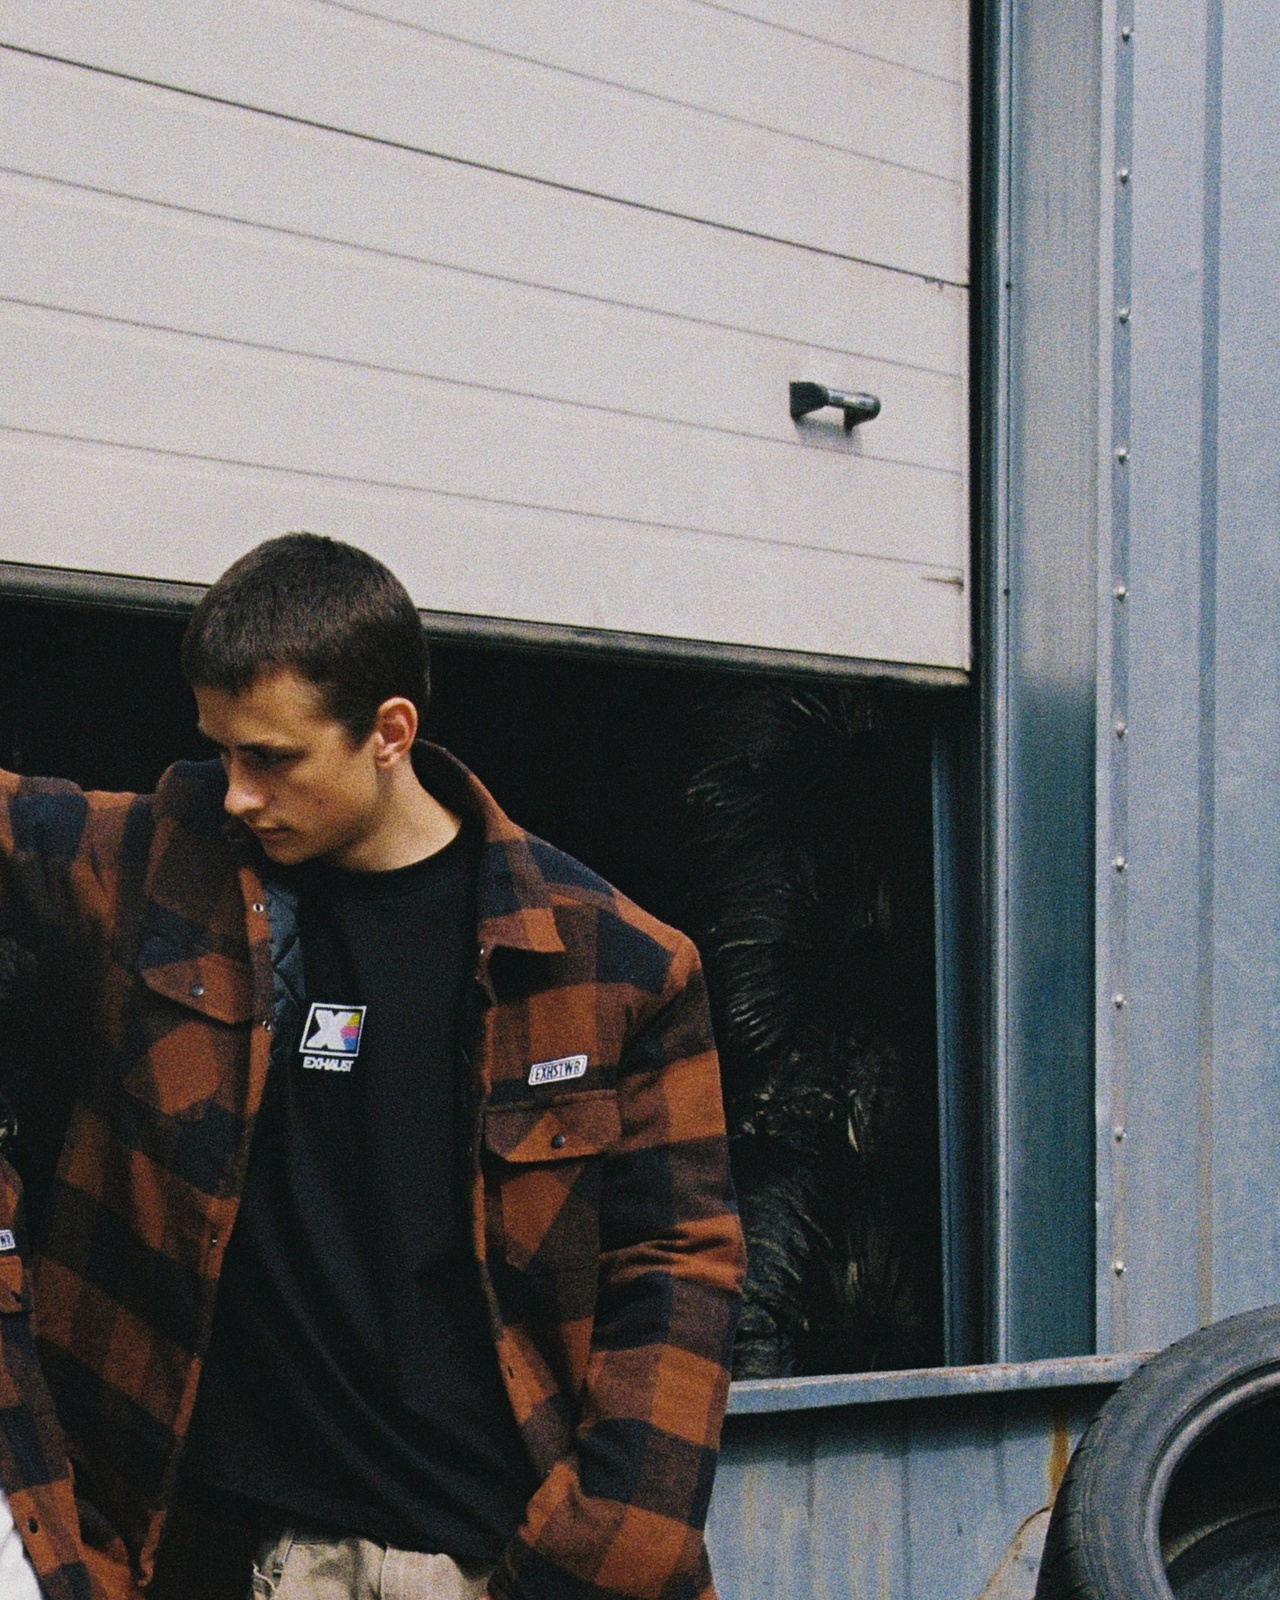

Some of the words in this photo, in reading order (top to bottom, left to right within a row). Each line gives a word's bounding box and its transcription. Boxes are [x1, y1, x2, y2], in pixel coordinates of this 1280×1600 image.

[306, 1010, 352, 1050] X
[303, 1056, 354, 1072] EXHAUST
[535, 1060, 581, 1080] EXHSTWR
